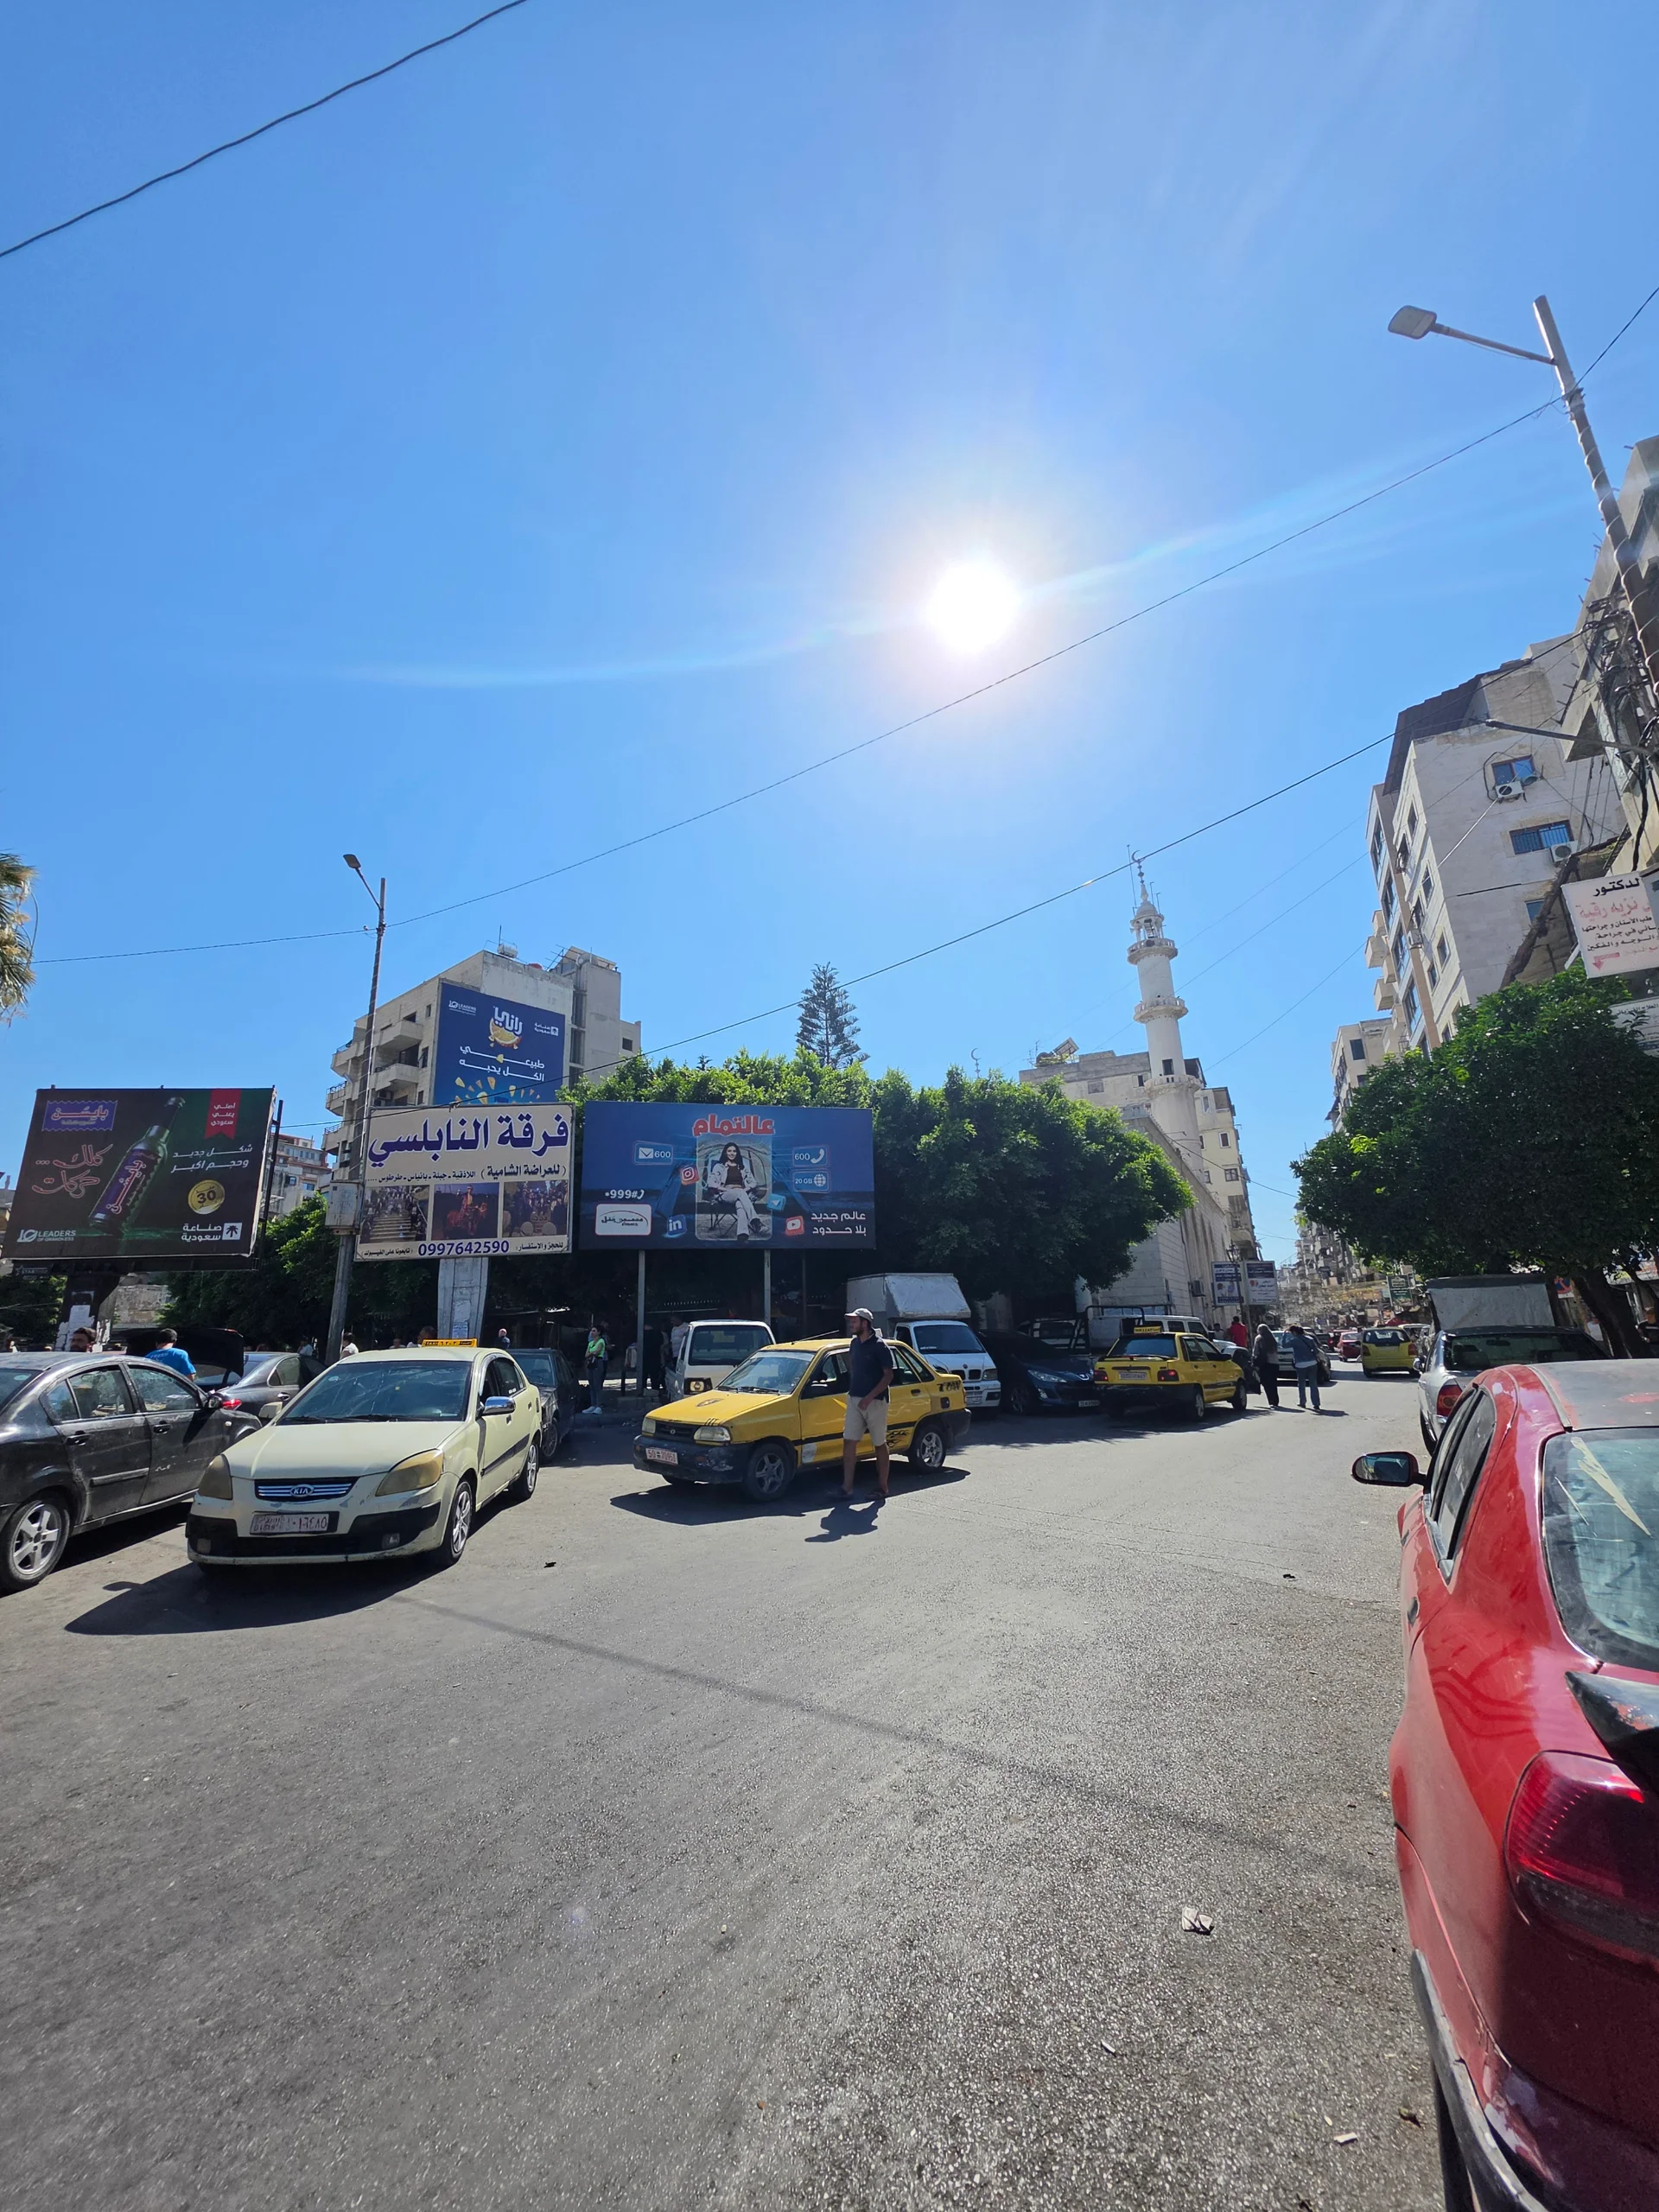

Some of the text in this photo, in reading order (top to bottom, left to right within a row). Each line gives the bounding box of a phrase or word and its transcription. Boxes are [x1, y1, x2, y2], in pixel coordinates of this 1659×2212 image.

[460, 1046, 545, 1069] طبيعي
[459, 1058, 544, 1082] الكل يحبه
[692, 1113, 775, 1137] عالتمام
[367, 1112, 570, 1168] فرقة النابلسي
[207, 1143, 253, 1157] شكل
[653, 1150, 671, 1159] 600
[205, 1159, 250, 1171] وحجم
[433, 1171, 447, 1181] جبلة
[196, 1190, 217, 1205] 30
[811, 1211, 866, 1223] عالم جديد
[182, 1223, 222, 1231] صناعة
[812, 1224, 867, 1236] بلا حدود
[181, 1232, 221, 1243] سعودية
[418, 1240, 510, 1256] 0997642590
